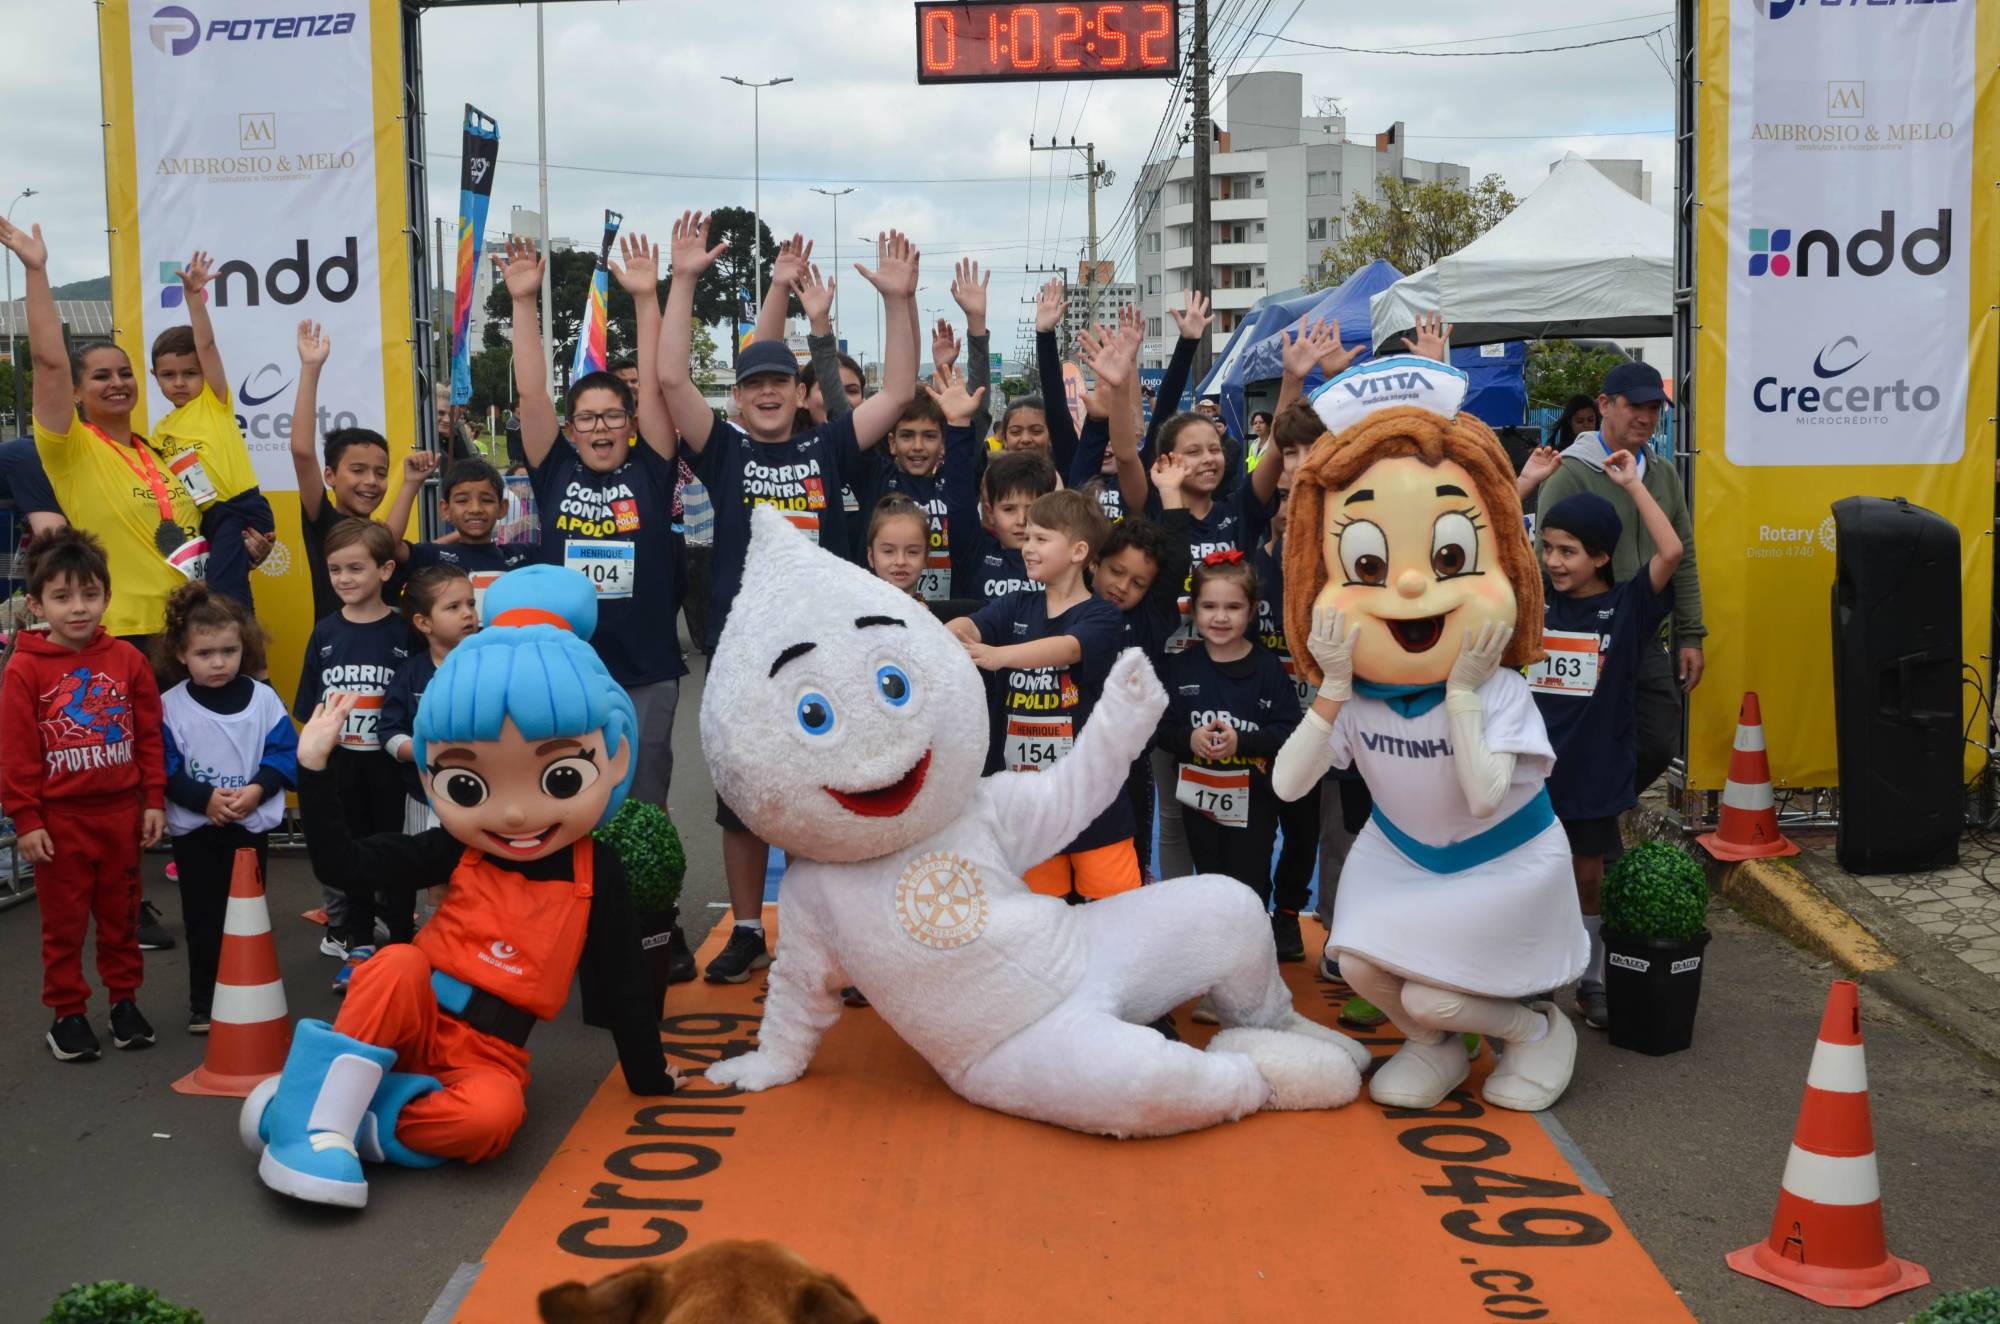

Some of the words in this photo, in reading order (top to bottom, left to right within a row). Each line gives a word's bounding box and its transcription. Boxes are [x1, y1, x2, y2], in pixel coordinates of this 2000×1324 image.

[1751, 123, 1859, 142] AMBROSIO
[1865, 125, 1880, 140] &
[1888, 122, 1954, 140] MELO
[155, 156, 272, 175] AMBROSIO
[276, 156, 291, 172] &
[295, 151, 356, 170] MELO
[1797, 208, 1952, 277] ndd
[215, 236, 359, 307] ndd
[1344, 371, 1434, 398] VITTA
[1753, 376, 1940, 413] Crecerto
[1796, 414, 1889, 426] MICROCRÉDITO
[742, 479, 806, 498] CONTRA
[616, 516, 639, 526] POLIO
[1759, 525, 1814, 544] Rotary
[580, 549, 624, 559] HENRIQUE
[1747, 547, 1782, 558] Distrito
[1785, 546, 1814, 558] 4740
[582, 564, 619, 583] 104
[1544, 656, 1581, 677] 163
[345, 714, 379, 734] 172
[1017, 726, 1060, 736] HENRIQUE
[1018, 742, 1057, 763] 154
[1360, 731, 1454, 758] VITTINH
[46, 740, 132, 777] SPIDER-MAN
[1195, 790, 1233, 811] 176
